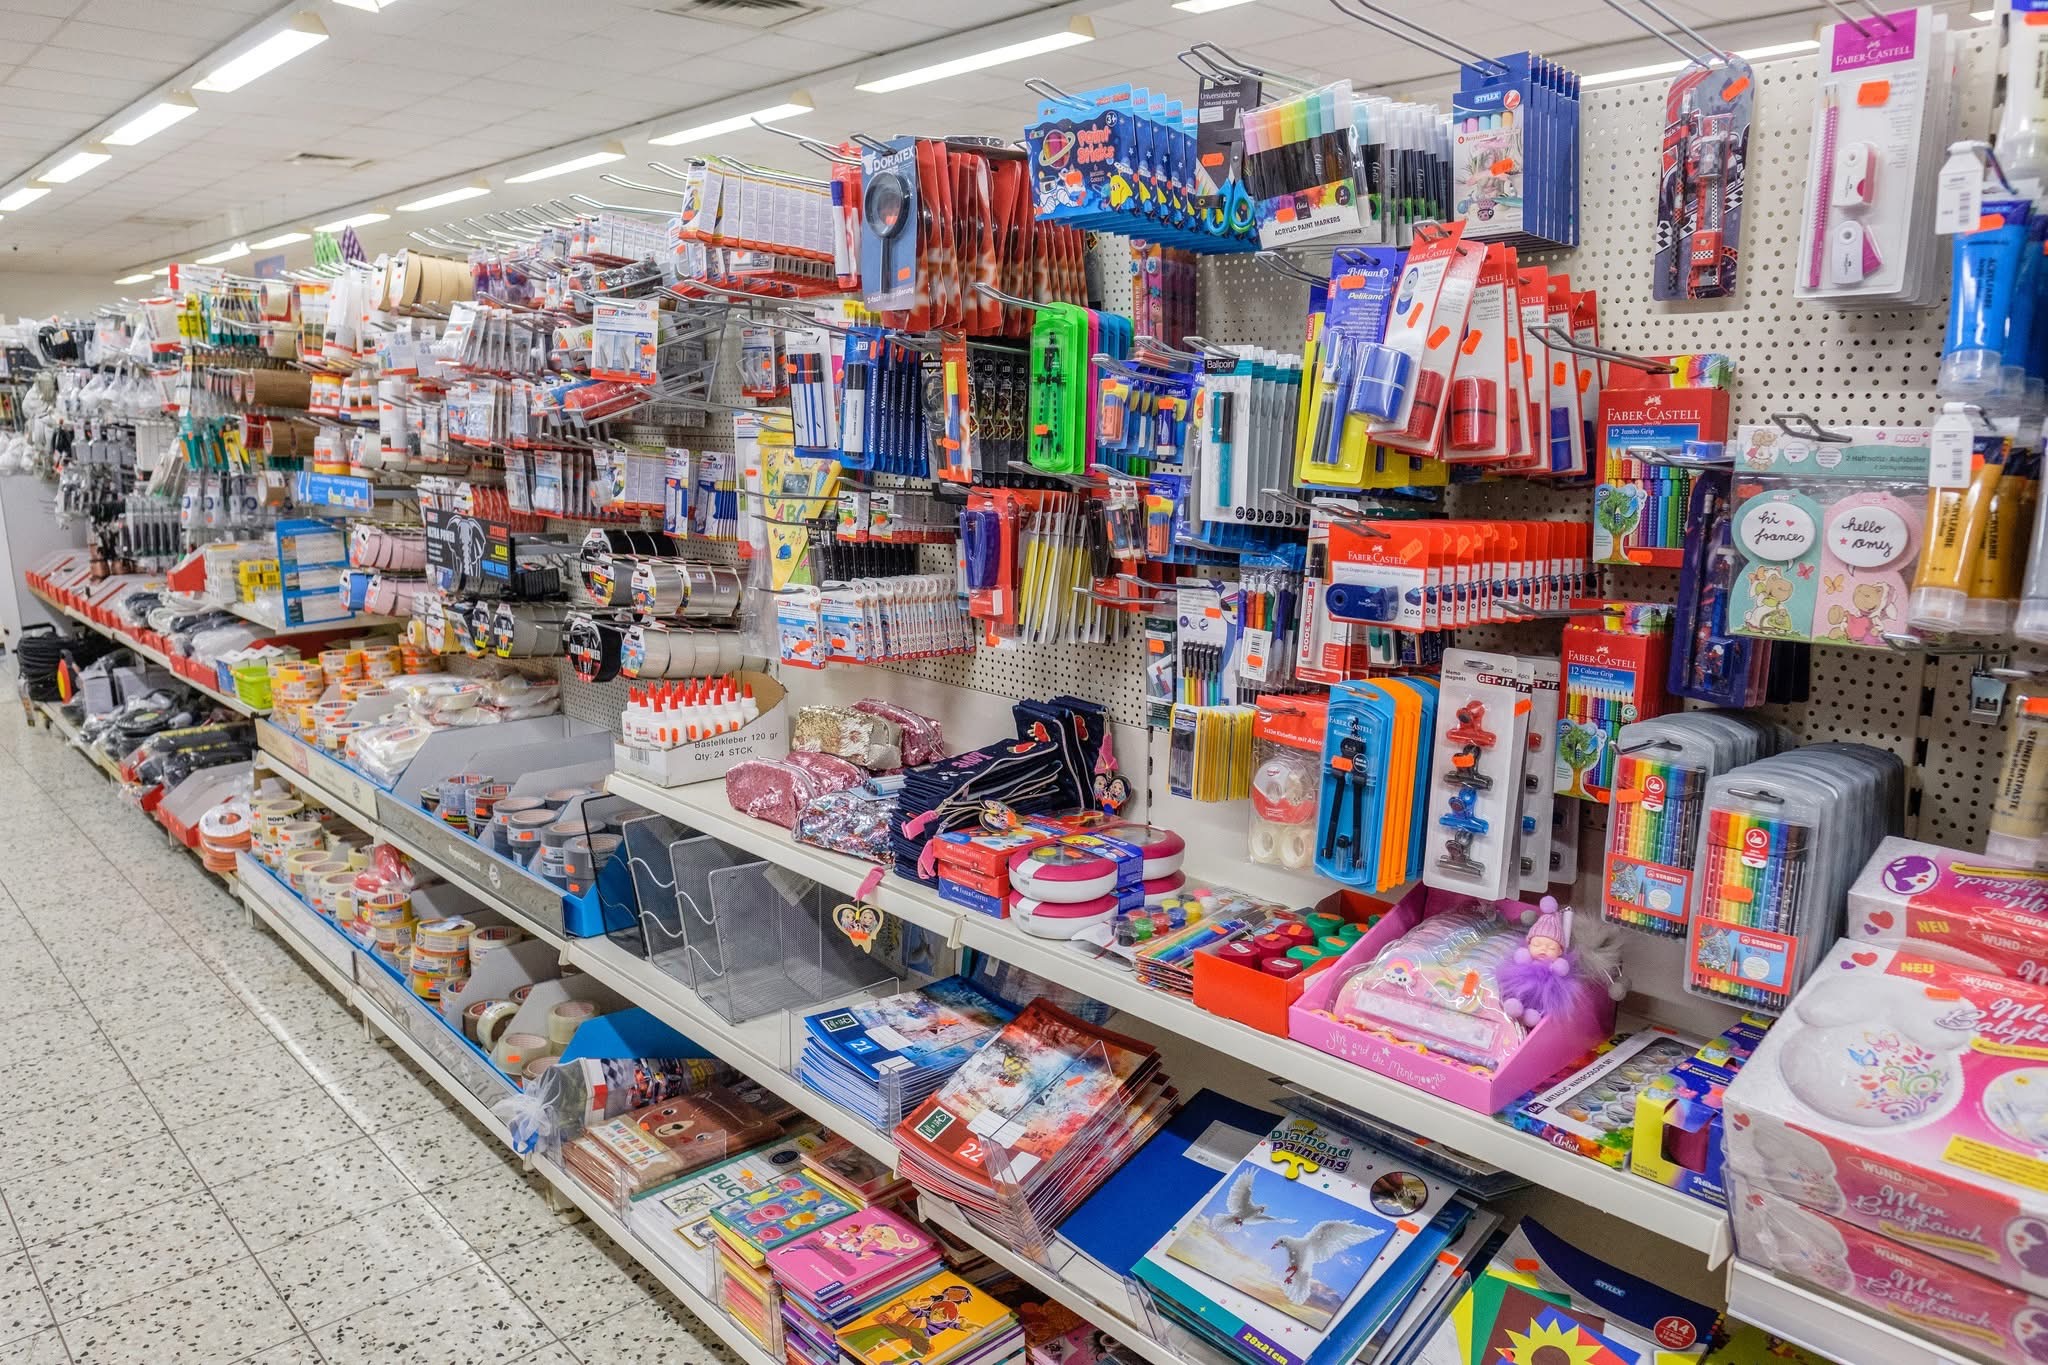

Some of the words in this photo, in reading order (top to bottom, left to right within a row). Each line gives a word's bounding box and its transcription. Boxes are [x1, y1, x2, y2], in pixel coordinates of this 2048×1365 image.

[1836, 45, 1911, 66] FABER-CASTELL
[1200, 91, 1241, 101] Universalschere
[1475, 92, 1500, 103] STYLEX
[1106, 113, 1117, 123] 3+
[1077, 126, 1111, 146] Paint
[873, 146, 915, 172] DORATEX
[1077, 145, 1116, 165] Sticks
[1274, 225, 1297, 236] ACRYLIC
[1297, 220, 1313, 232] PAINT
[1313, 215, 1341, 230] MARKERS
[1341, 227, 1362, 235] RKERS
[1408, 247, 1453, 264] FABER-CASTELL
[1347, 267, 1381, 279] Pelikan
[1478, 274, 1504, 285] ASTELL
[1348, 293, 1384, 301] Pelikano
[1548, 303, 1569, 312] STELL
[1573, 318, 1595, 328] STELL
[1207, 360, 1235, 372] Ballpoint
[1607, 407, 1701, 422] FABER-CASTELL
[1610, 428, 1619, 438] 12
[1621, 427, 1640, 435] Jumbo
[1640, 427, 1655, 436] Grip
[1895, 433, 1921, 443] NICI
[1758, 511, 1781, 525] hi
[1842, 517, 1886, 534] hello
[427, 526, 440, 539] ULTRA
[440, 529, 456, 544] POWER
[1754, 529, 1806, 545] frances
[1348, 551, 1408, 565] FABER-CASTELL
[1305, 594, 1313, 623] edding
[1303, 624, 1311, 651] 3000
[1568, 650, 1637, 669] FABER-CASTELL
[1478, 674, 1514, 687] GET-IT.
[1571, 666, 1579, 675] 12
[1580, 667, 1599, 676] Colour
[1600, 670, 1614, 679] Grip
[1329, 715, 1373, 734] FABER-CASTELL
[694, 735, 747, 749] Bastelkleber
[751, 732, 766, 742] 120
[769, 732, 779, 741] gr
[1297, 735, 1308, 743] mit
[694, 752, 713, 762] Qty:
[714, 750, 725, 759] 24
[729, 746, 753, 757] STCK
[1655, 873, 1682, 884] STABILO
[1918, 920, 1950, 934] NEU
[1751, 938, 1783, 951] STABILO
[1900, 962, 1936, 974] NEU
[1989, 997, 2048, 1024] Me
[1935, 1008, 2048, 1045] Babyb
[850, 1040, 873, 1052] 21
[1352, 1042, 1369, 1055] and
[1371, 1050, 1385, 1066] the
[1543, 1086, 1571, 1103] METALLIC
[1569, 1063, 1606, 1088] WATERCOLOUR
[1270, 1130, 1353, 1159] Diamond
[1552, 1132, 1580, 1152] Artist
[960, 1142, 984, 1162] 22
[1879, 1184, 1948, 1219] Mein
[1852, 1194, 1984, 1244] Babybauch
[817, 1281, 841, 1294] KOSMOS
[1594, 1279, 1626, 1297] STYLEX
[1889, 1268, 1959, 1304] Mein
[829, 1294, 853, 1308] KOSMOS
[1863, 1276, 1992, 1328] Babybauch
[1666, 1319, 1691, 1335] A4
